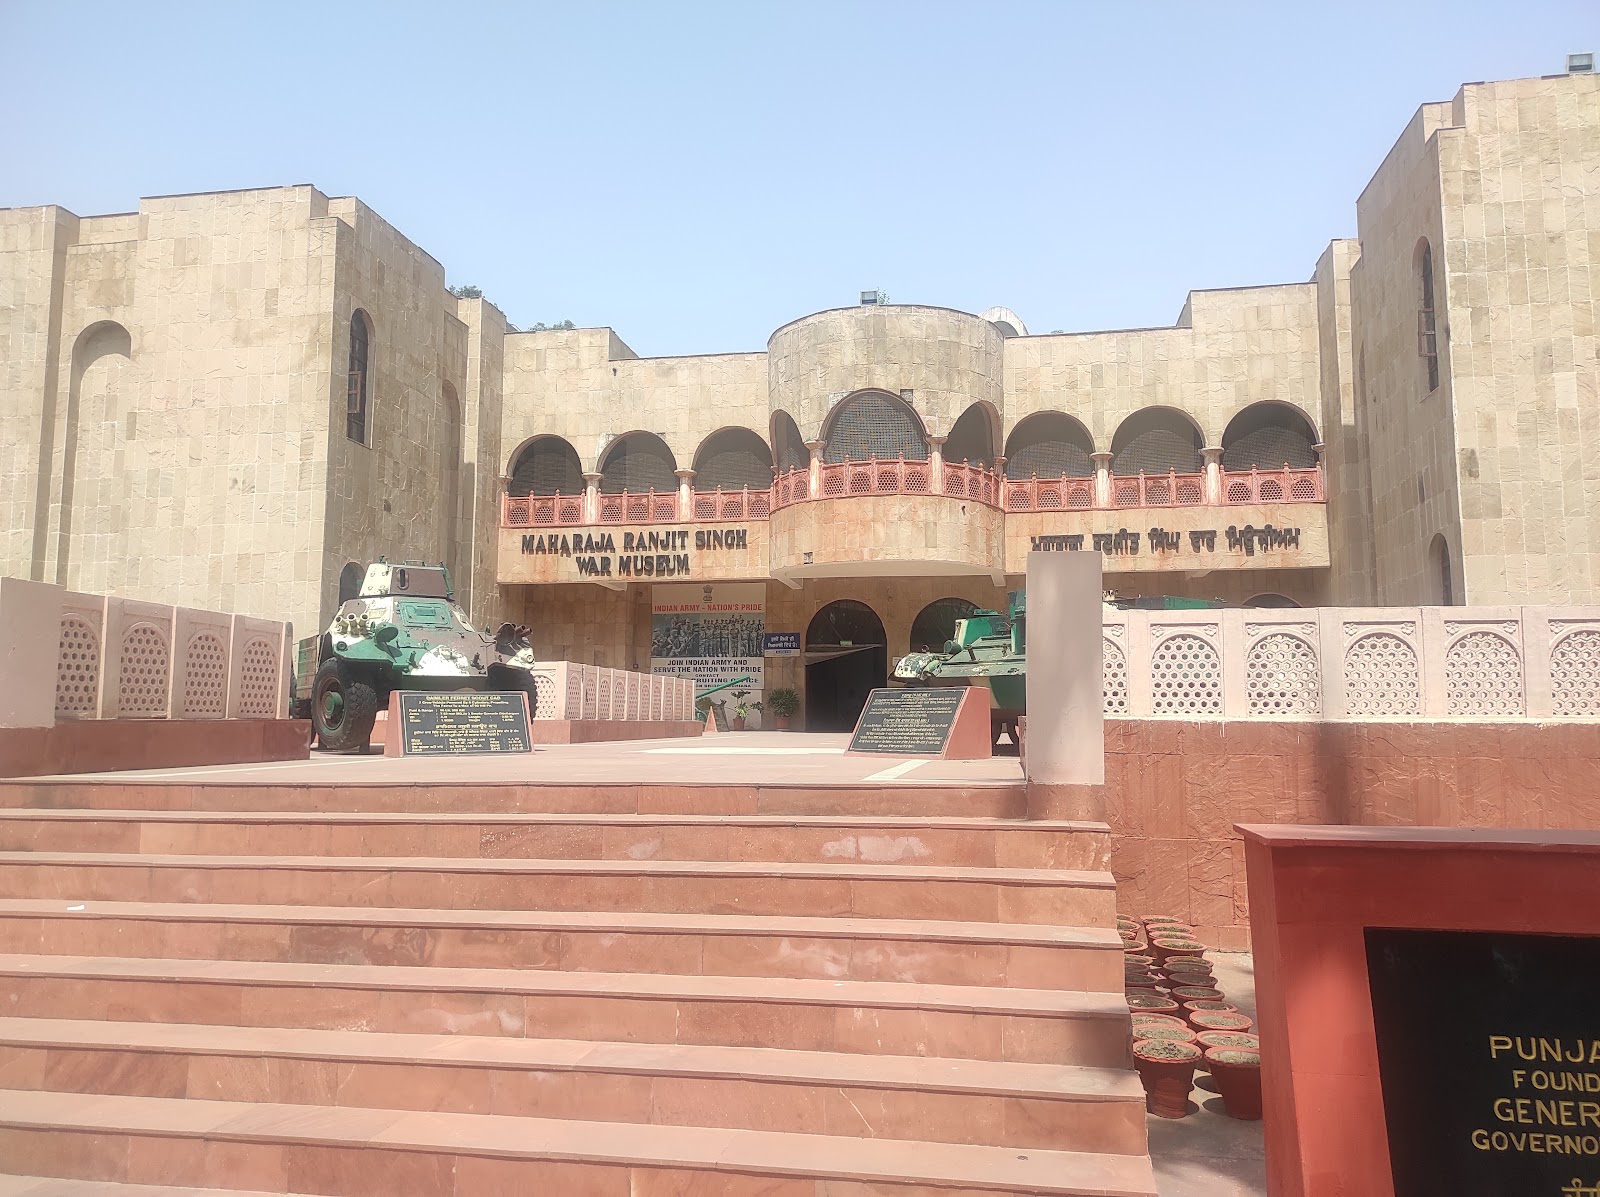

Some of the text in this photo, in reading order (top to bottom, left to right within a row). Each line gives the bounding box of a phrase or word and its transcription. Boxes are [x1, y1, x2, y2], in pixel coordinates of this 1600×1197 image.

[521, 529, 748, 558] MAHARAJA RANJIT SINGH
[1092, 528, 1140, 555] ਰਣਜੀਤ
[1147, 527, 1181, 554] ਸਿੰਘ
[1188, 529, 1217, 553] ਵਾਰ
[575, 553, 690, 576] WAR MUSEUM
[680, 604, 700, 612] ARMY
[741, 603, 762, 611] PRIDE
[1512, 1069, 1600, 1093] FOUND
[1493, 1098, 1600, 1128] GENER
[1471, 1128, 1600, 1155] GOVERNO
